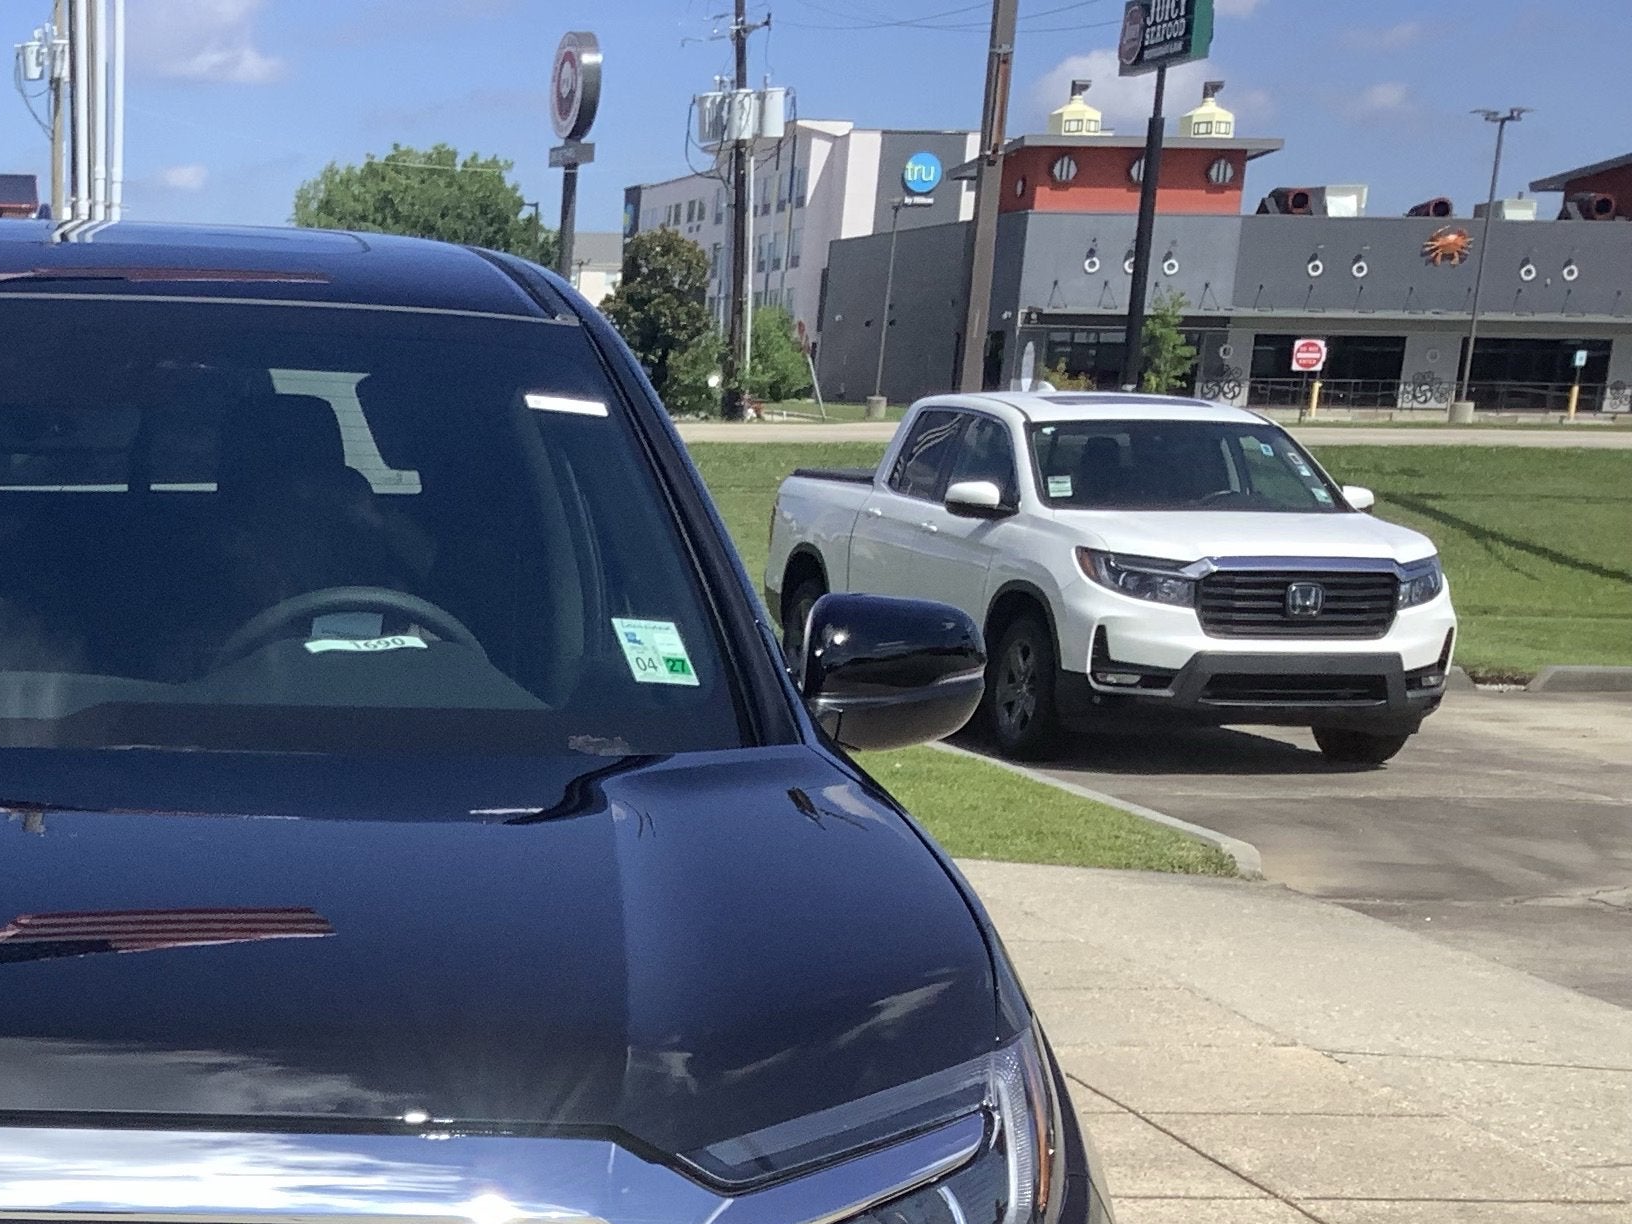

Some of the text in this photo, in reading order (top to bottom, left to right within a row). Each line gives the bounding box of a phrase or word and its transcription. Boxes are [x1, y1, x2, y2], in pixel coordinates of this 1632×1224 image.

[1144, 18, 1186, 45] SEAFOOD
[905, 161, 935, 182] tru
[350, 637, 406, 650] 1690
[635, 656, 686, 673] 04 27
